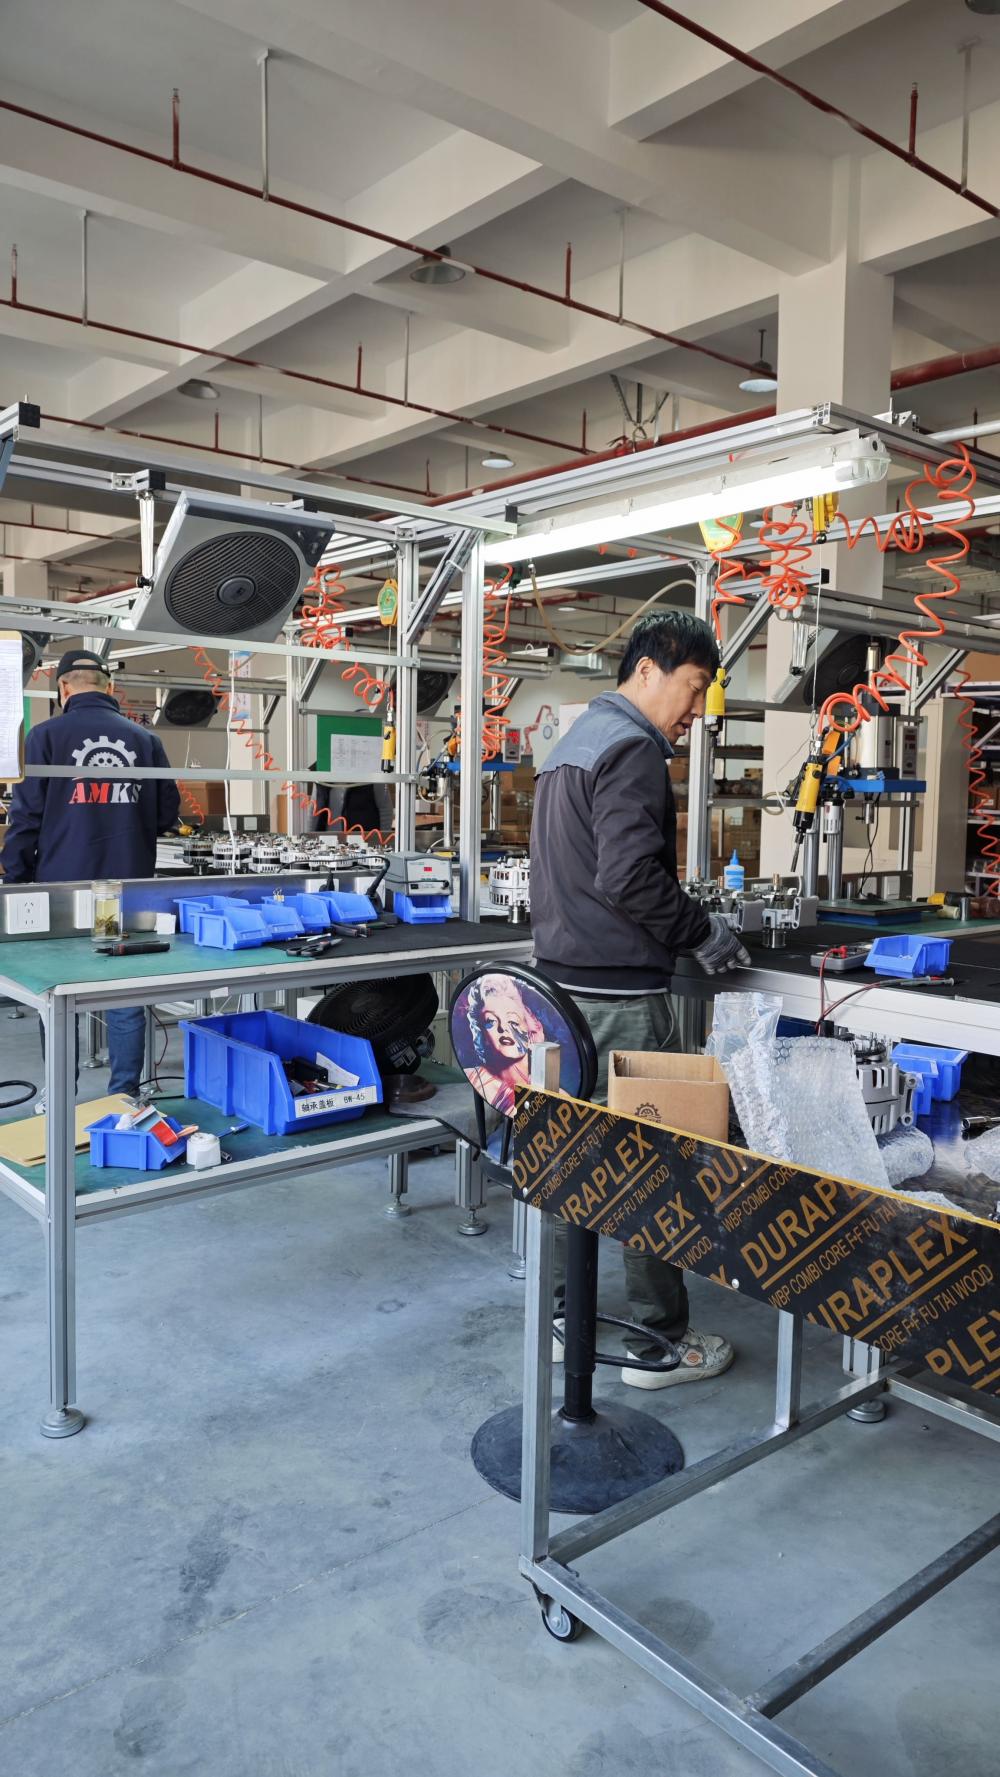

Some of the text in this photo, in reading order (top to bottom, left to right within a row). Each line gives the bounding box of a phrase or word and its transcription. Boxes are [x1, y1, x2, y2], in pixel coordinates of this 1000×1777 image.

[69, 782, 142, 803] AMKS
[541, 1172, 563, 1199] COMBI
[560, 1151, 580, 1178] CORE
[623, 1196, 637, 1216] FU
[633, 1186, 648, 1205] TAI
[644, 1164, 670, 1195] WOOD
[721, 1207, 743, 1233] WBP
[741, 1182, 773, 1216] COMBI
[684, 1235, 712, 1266] WOOD
[768, 1285, 791, 1308] WBP
[790, 1261, 823, 1294] COMBI
[819, 1239, 851, 1271] CORE
[860, 1218, 880, 1238] FU
[874, 1200, 898, 1225] TAI
[917, 1301, 939, 1325] FU
[933, 1289, 958, 1313] TAI
[951, 1263, 995, 1301] WOOD
[925, 1310, 1000, 1377] PLE
